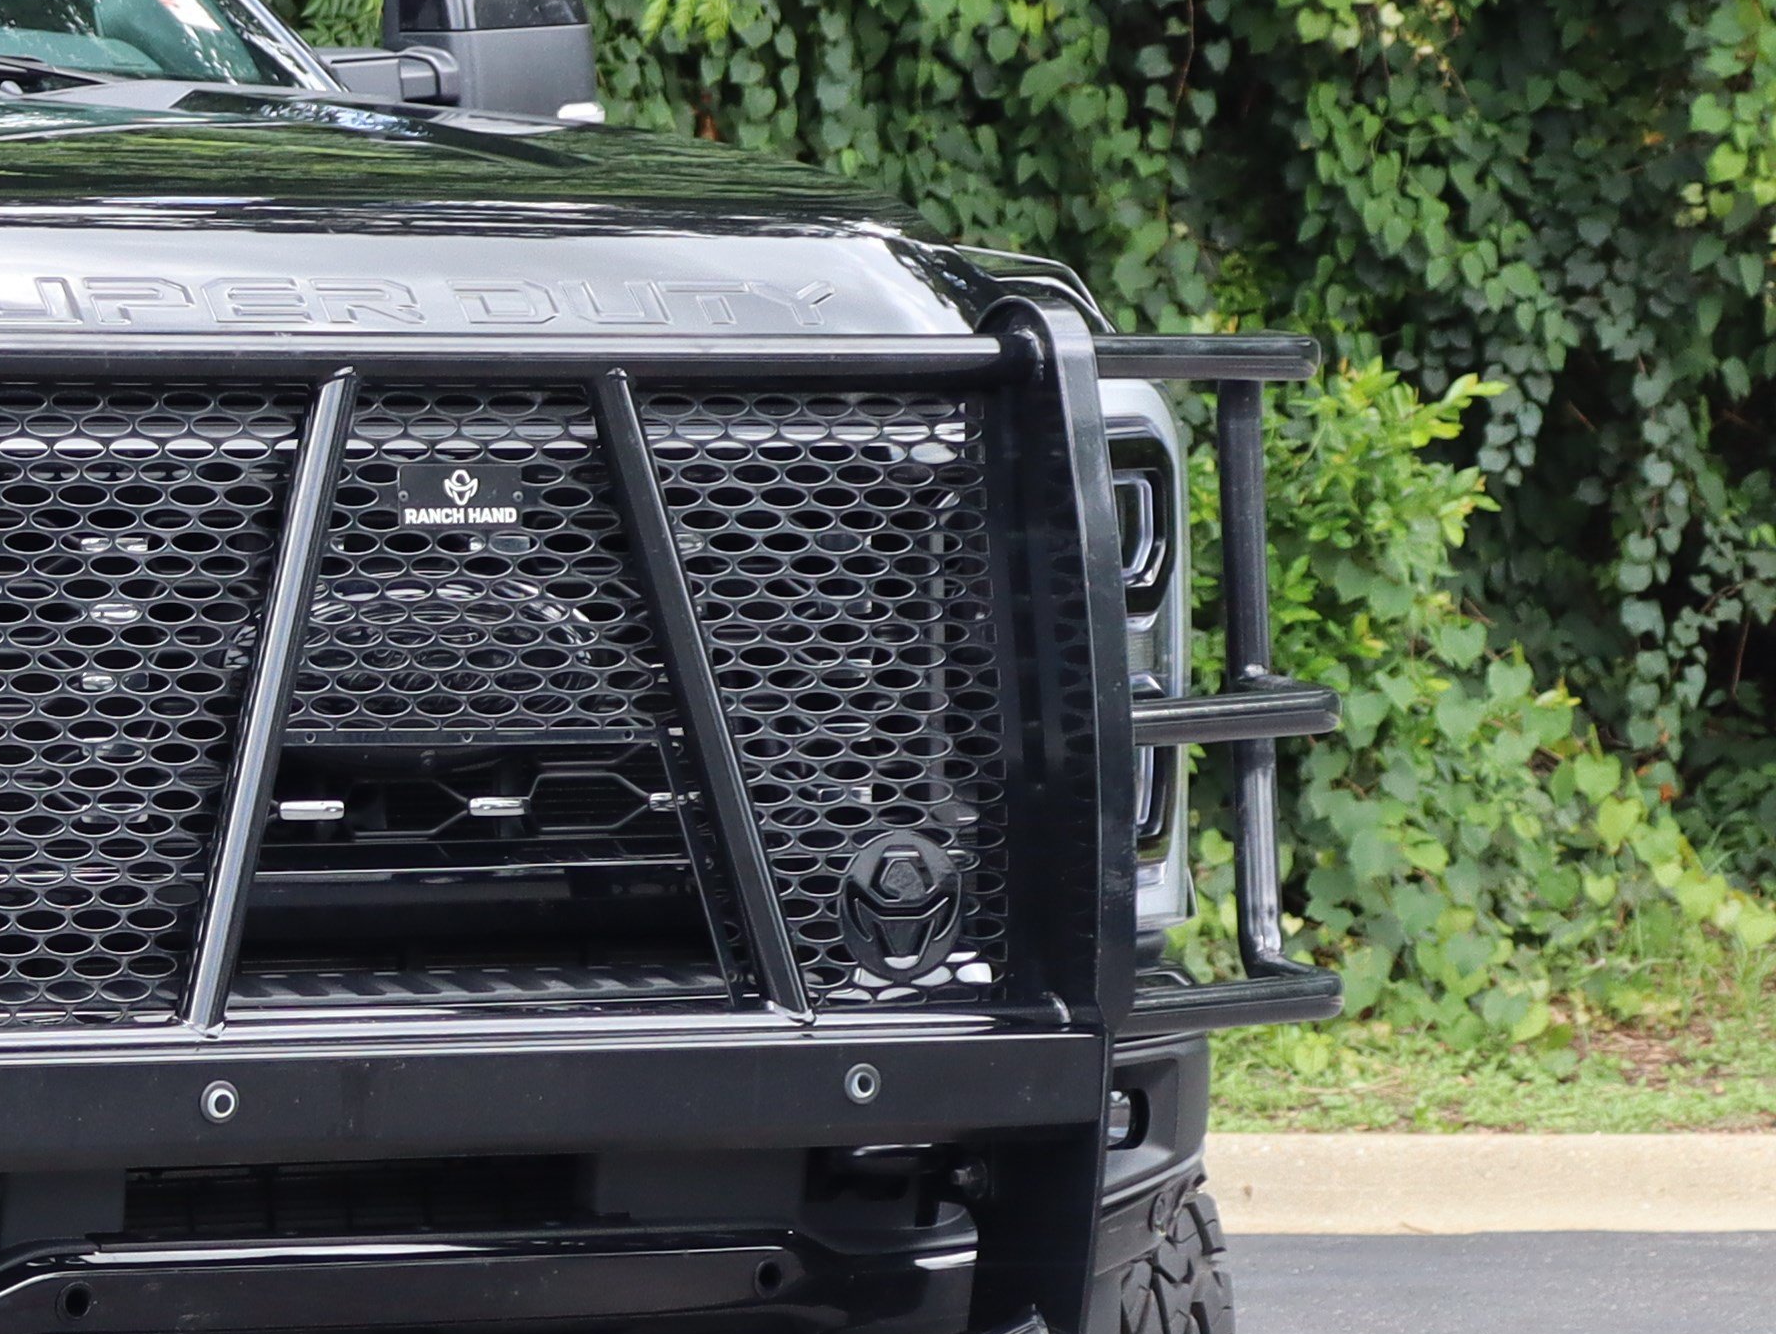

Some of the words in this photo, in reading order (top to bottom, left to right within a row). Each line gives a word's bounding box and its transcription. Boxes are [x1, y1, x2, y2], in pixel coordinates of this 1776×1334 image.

[446, 277, 837, 326] DUTY
[404, 507, 465, 525] RANCH
[468, 506, 518, 524] HAND
